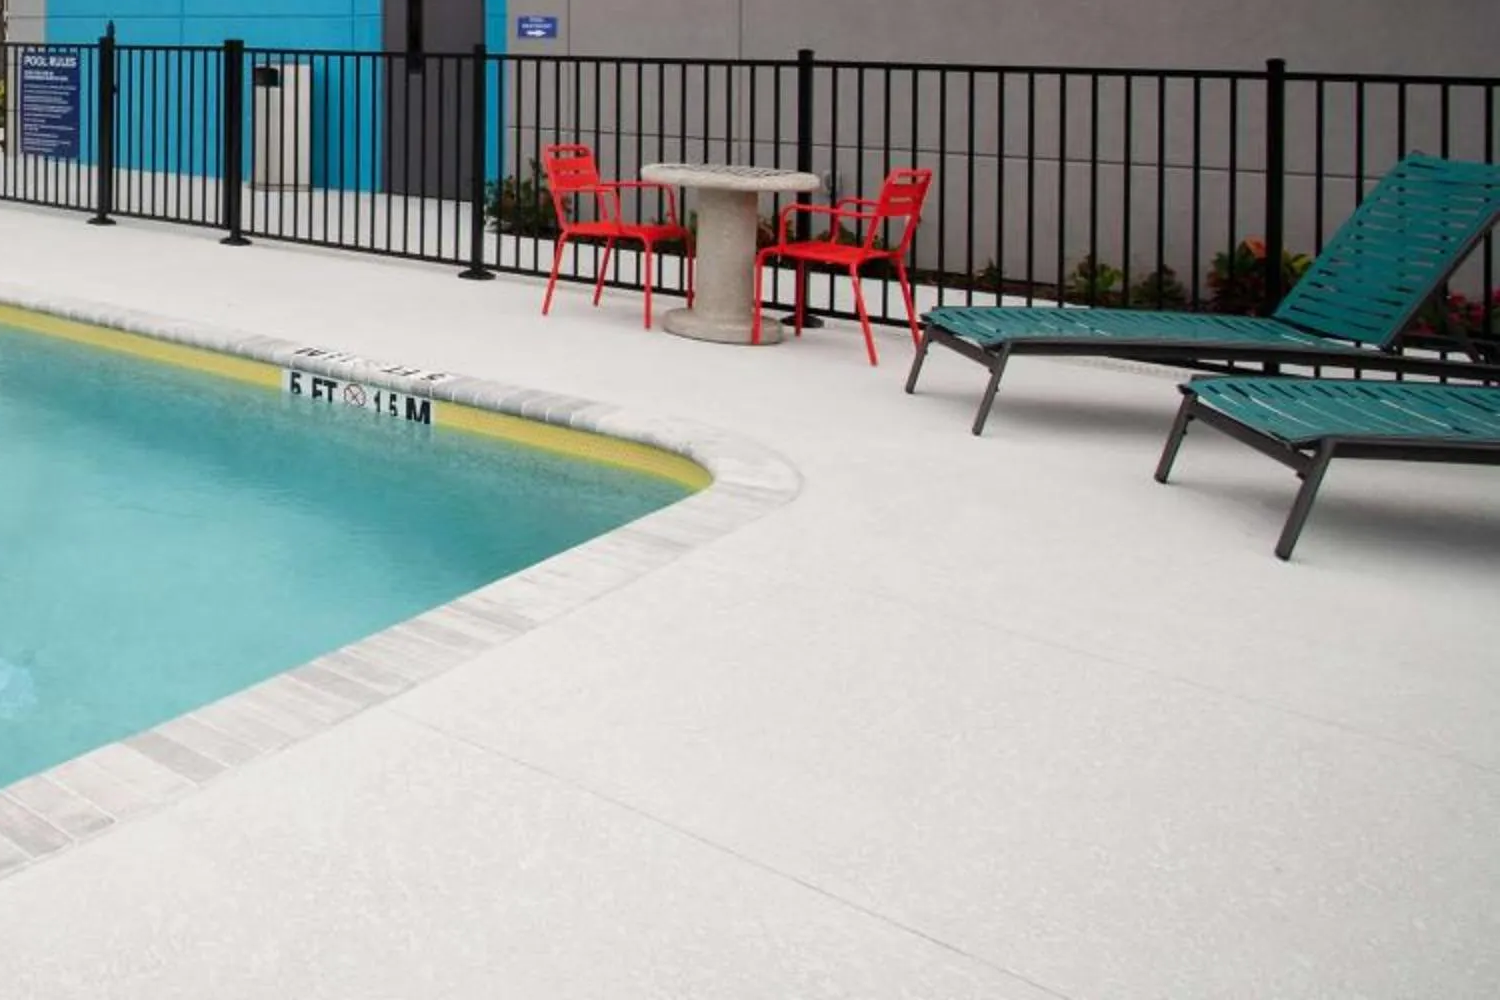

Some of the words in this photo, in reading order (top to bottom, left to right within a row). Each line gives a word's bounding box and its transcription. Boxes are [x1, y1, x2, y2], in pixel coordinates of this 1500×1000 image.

[24, 55, 49, 67] POOL
[50, 56, 76, 68] RULES
[311, 376, 338, 404] FT
